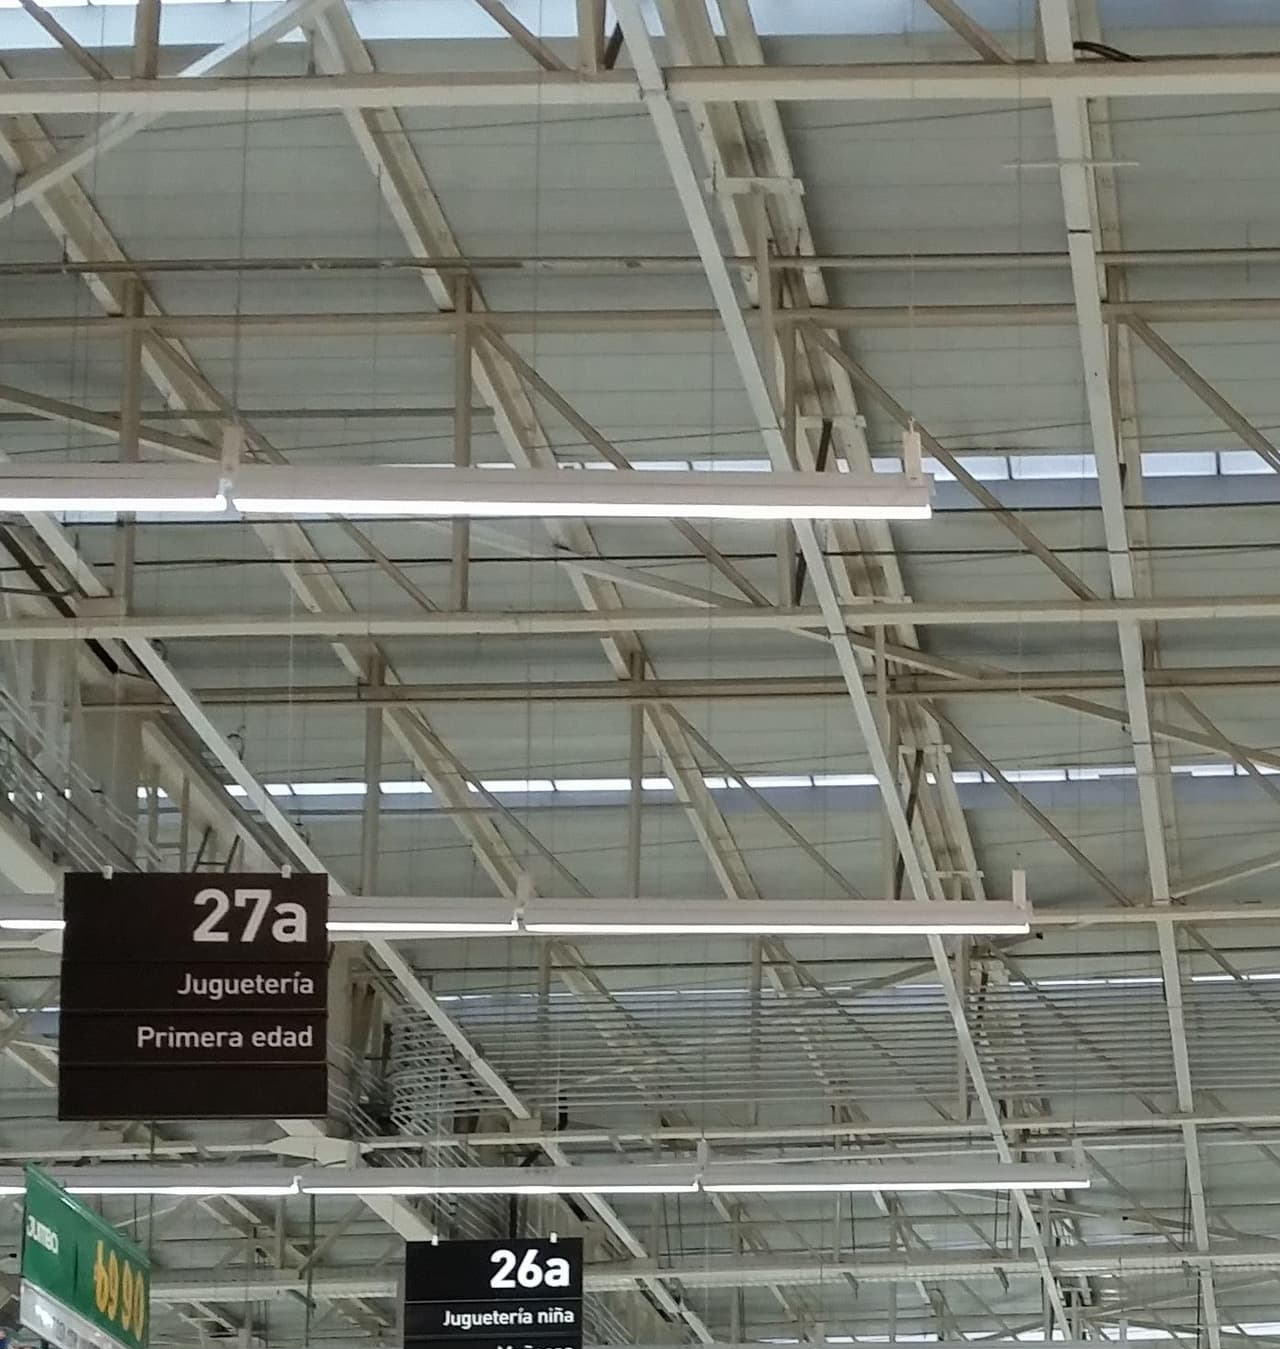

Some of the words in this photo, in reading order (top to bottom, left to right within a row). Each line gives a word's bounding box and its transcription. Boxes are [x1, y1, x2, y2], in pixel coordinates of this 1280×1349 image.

[193, 888, 308, 942] 27a
[177, 971, 315, 1001] Juguetería
[136, 1026, 243, 1048] Primera
[252, 1025, 313, 1048] edad
[490, 1248, 570, 1289] 26a
[442, 1307, 534, 1331] Juguetería
[537, 1306, 575, 1325] niña
